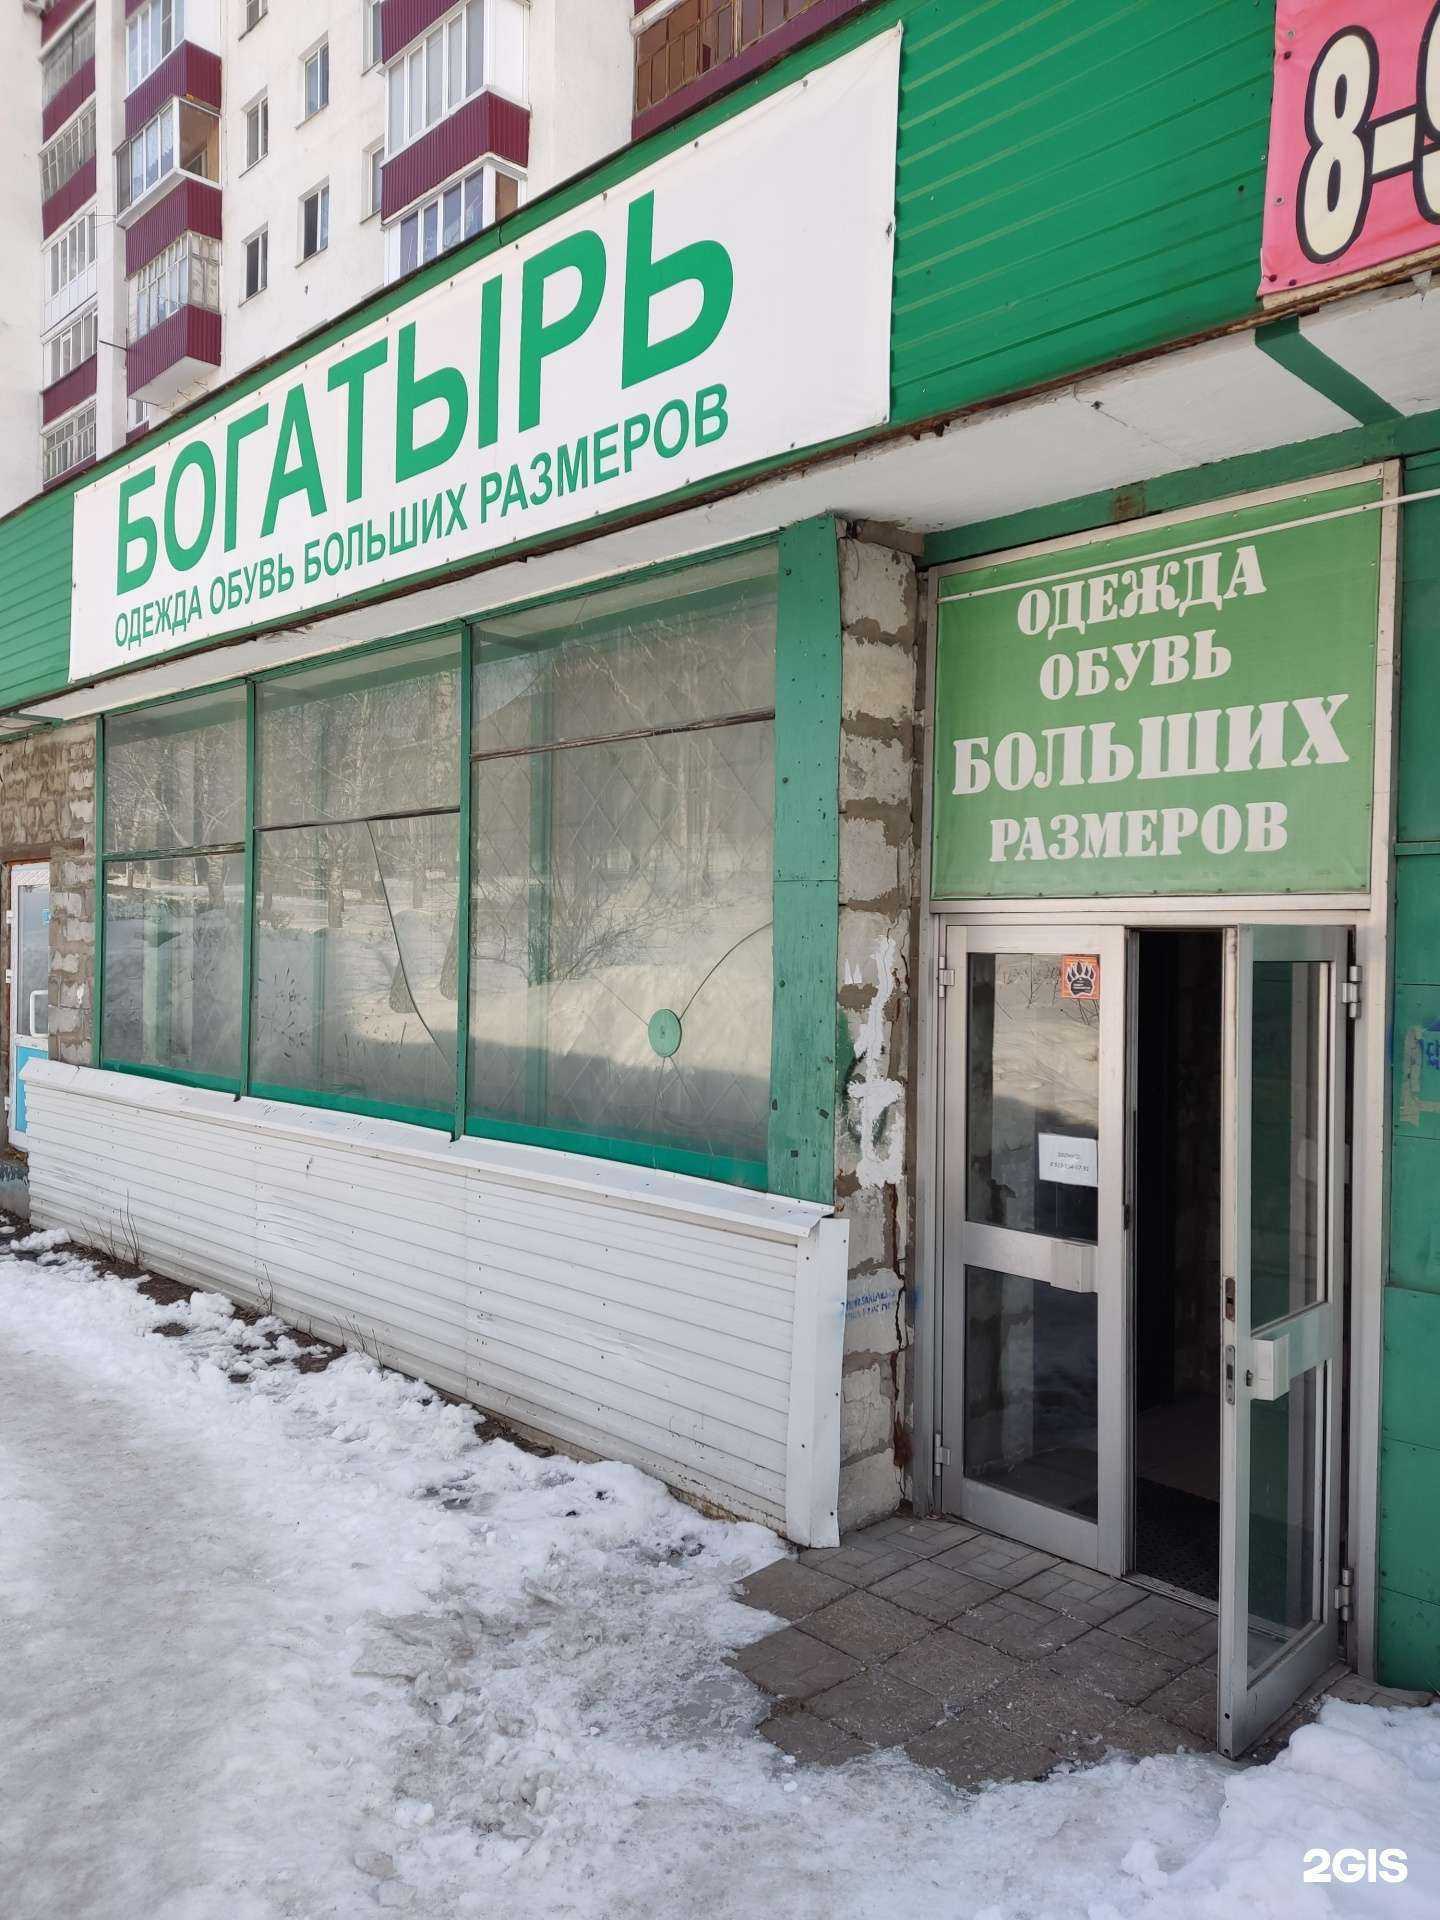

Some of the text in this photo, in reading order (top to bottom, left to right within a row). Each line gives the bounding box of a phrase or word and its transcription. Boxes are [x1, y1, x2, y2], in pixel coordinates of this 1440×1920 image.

[117, 190, 733, 595] БОГАТЫРЬ
[115, 383, 729, 649] ОДЕЖДА ОБУВЬ БОЛЬШИХ РАЗМЕРОВ
[1017, 545, 1266, 639] ОДЕЖДА
[1040, 630, 1231, 700] ОБУВЬ
[952, 694, 1349, 795] БОЛЬШИХ
[990, 801, 1288, 862] РАЗМЕРОВ
